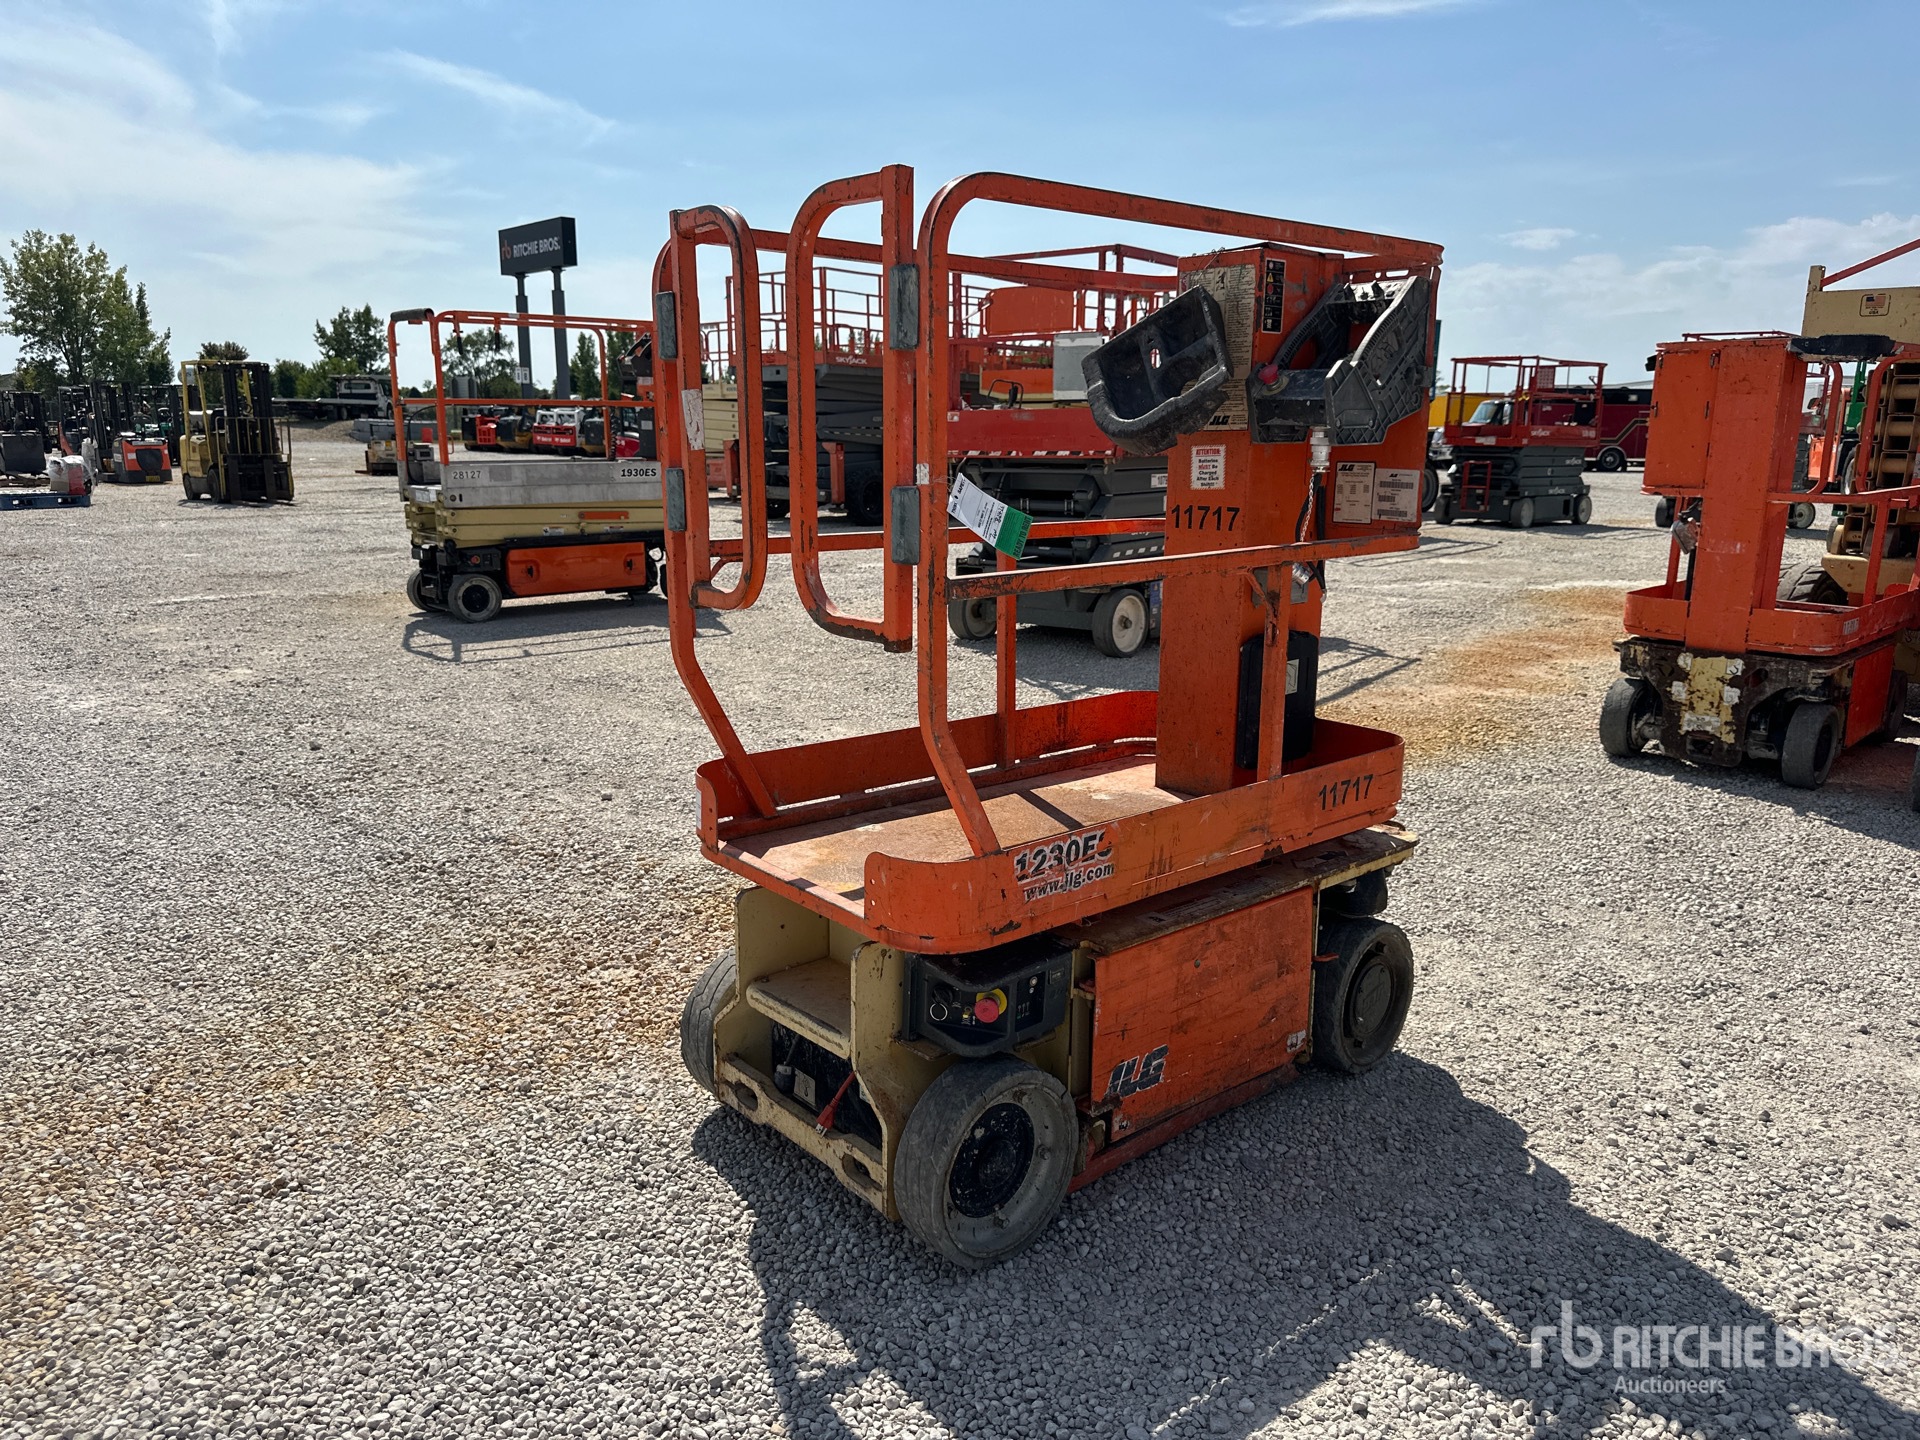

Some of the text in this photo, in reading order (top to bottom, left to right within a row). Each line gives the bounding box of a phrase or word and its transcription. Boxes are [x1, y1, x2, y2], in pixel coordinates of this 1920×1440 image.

[513, 240, 539, 258] RITCHIE
[835, 355, 868, 365] SKYJACK
[1209, 415, 1231, 425] JLG
[620, 468, 657, 478] 1930ES
[1338, 463, 1356, 472] JLG
[452, 470, 482, 480] 28127
[1171, 503, 1241, 532] 11717
[1318, 773, 1374, 811] 11717
[1023, 863, 1115, 902] www.jlg.com
[1104, 1043, 1170, 1099] JLG
